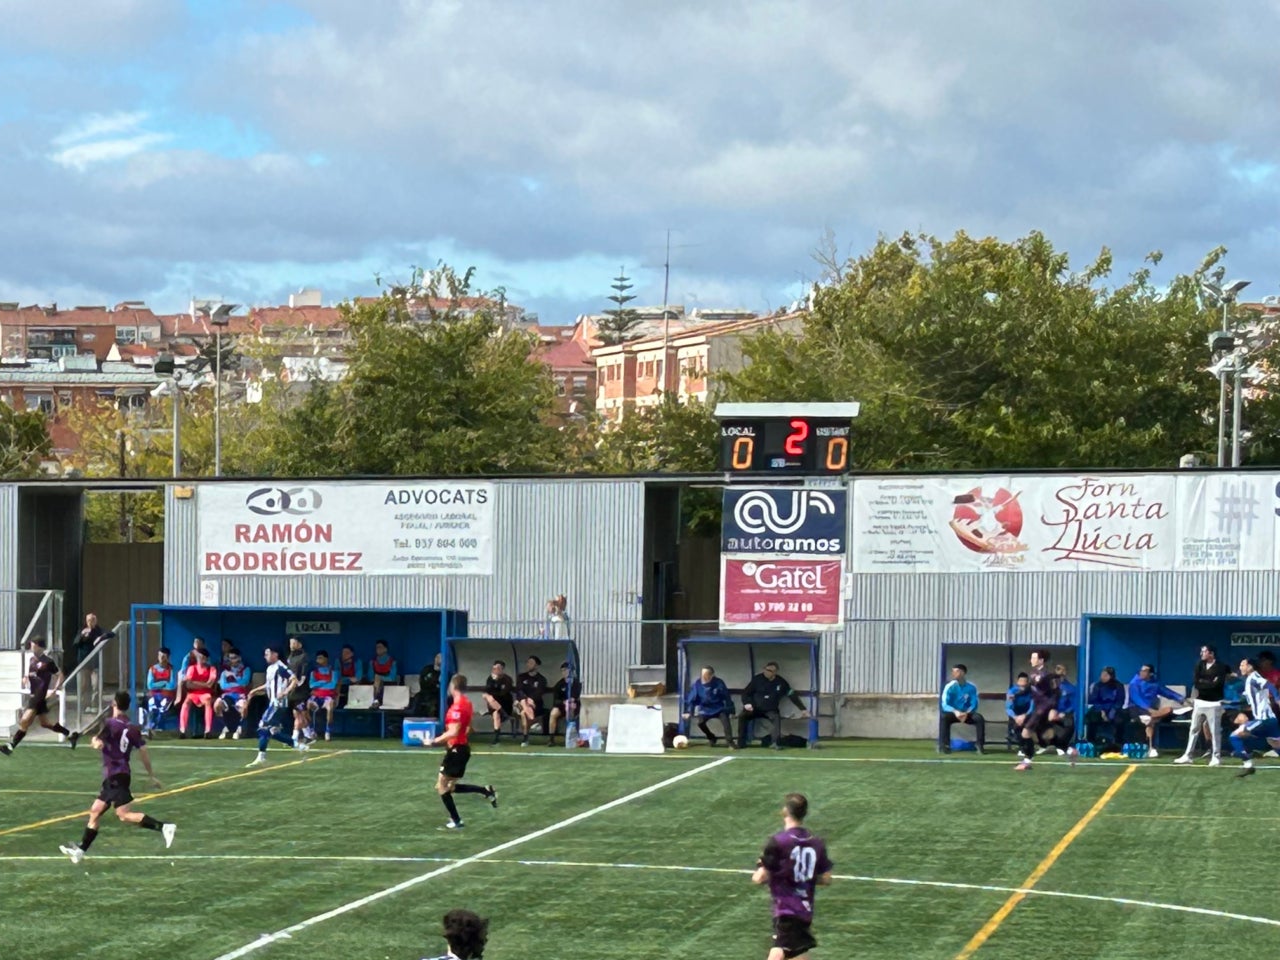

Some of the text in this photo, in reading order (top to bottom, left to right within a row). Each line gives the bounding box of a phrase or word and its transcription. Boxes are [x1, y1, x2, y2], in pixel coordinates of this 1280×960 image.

[721, 427, 756, 436] LOCAL
[785, 420, 808, 454] 2
[732, 437, 754, 470] 0
[826, 437, 848, 470] 0
[384, 489, 488, 505] ADVOCATS
[1071, 477, 1137, 500] Forn
[1041, 485, 1169, 526] Santa
[235, 519, 332, 543] RAMÓN
[1042, 519, 1160, 560] Llúcia
[728, 537, 840, 551] autoramos
[205, 547, 363, 571] RODRÍGUEZ
[120, 728, 129, 753] 6
[790, 846, 817, 882] 10
